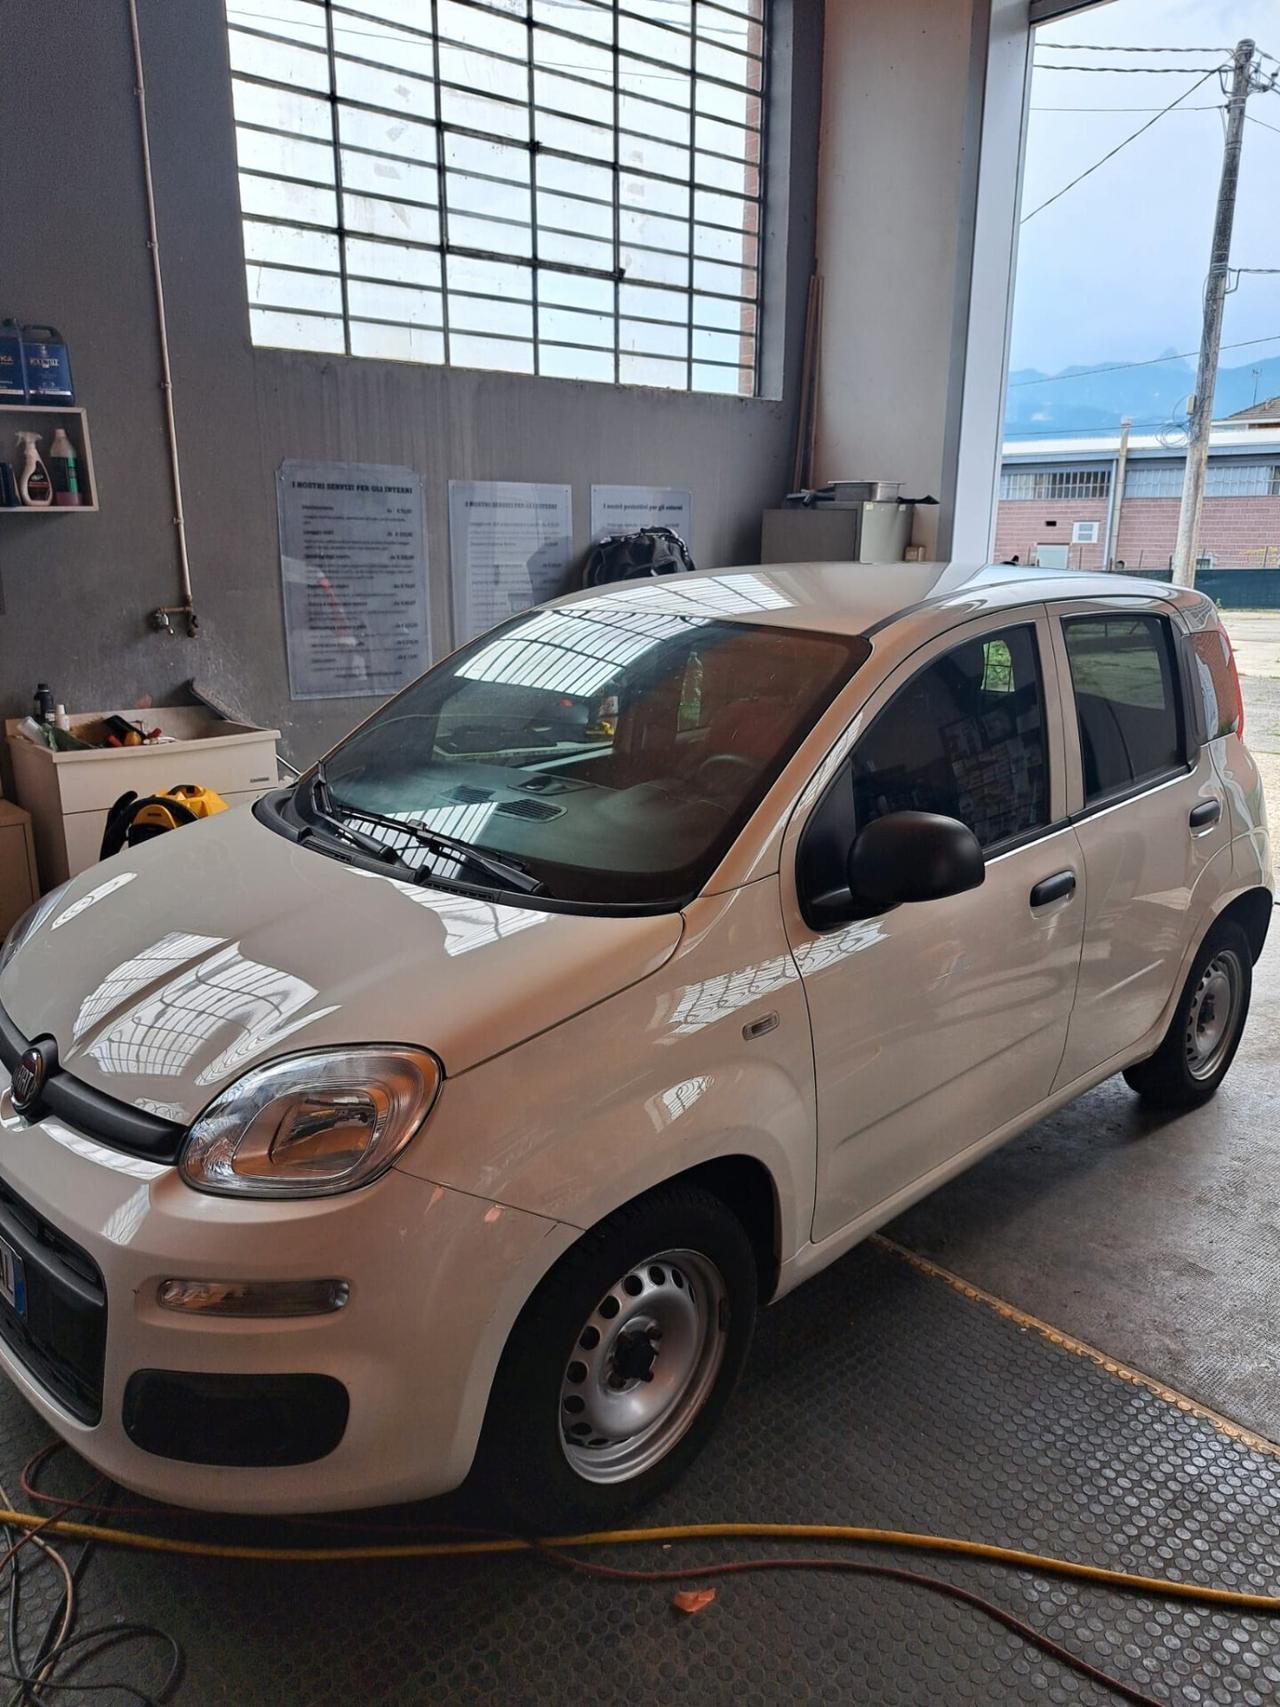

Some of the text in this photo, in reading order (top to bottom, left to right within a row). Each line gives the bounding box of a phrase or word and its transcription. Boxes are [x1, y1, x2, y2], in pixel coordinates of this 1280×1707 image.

[297, 481, 325, 490] NOSTRI
[327, 483, 354, 492] SERVIZI
[356, 485, 370, 493] PER
[371, 485, 383, 494] GLI
[384, 486, 413, 495] INTERNI
